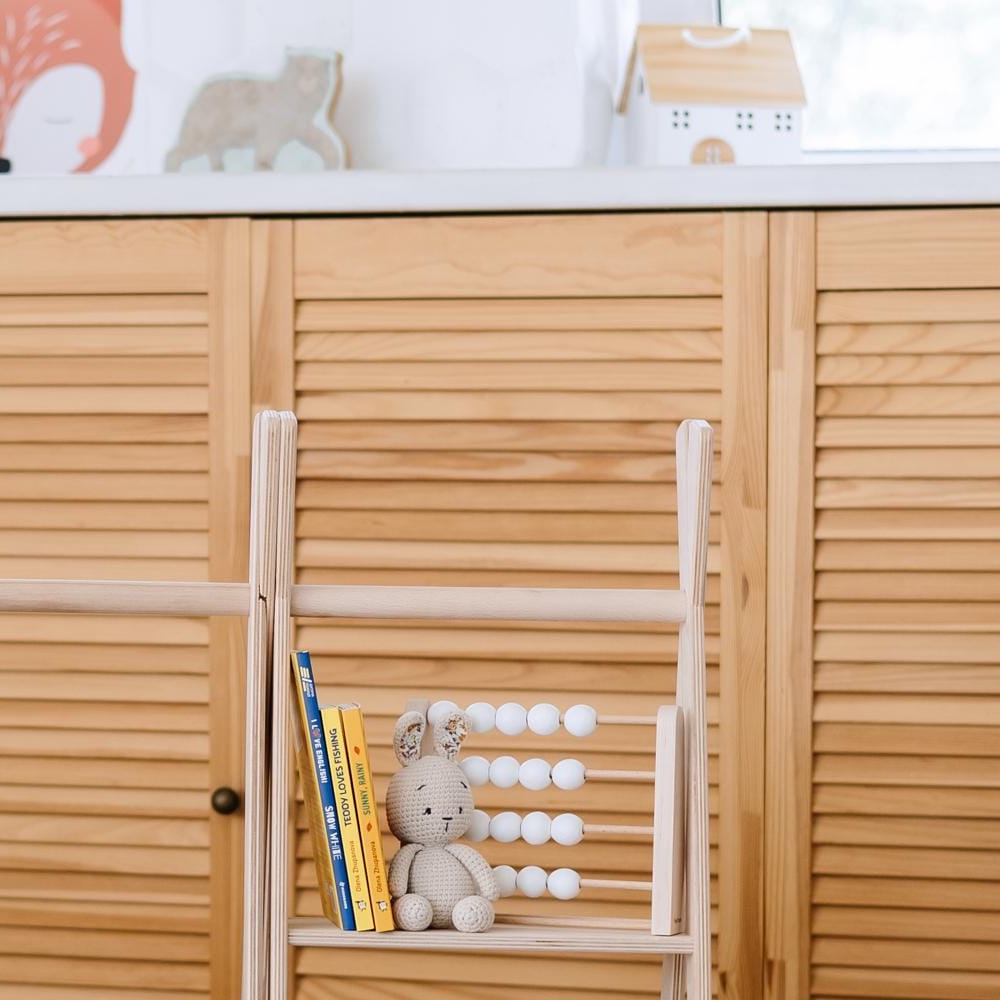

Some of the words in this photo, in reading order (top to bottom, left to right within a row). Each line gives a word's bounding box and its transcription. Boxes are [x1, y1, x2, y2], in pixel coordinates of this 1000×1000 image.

[329, 728, 341, 764] FISHING
[336, 765, 346, 795] LOVES
[355, 762, 366, 785] RAINY
[324, 805, 337, 830] SNOW
[340, 797, 351, 827] TEDDY
[330, 832, 342, 860] WHITE
